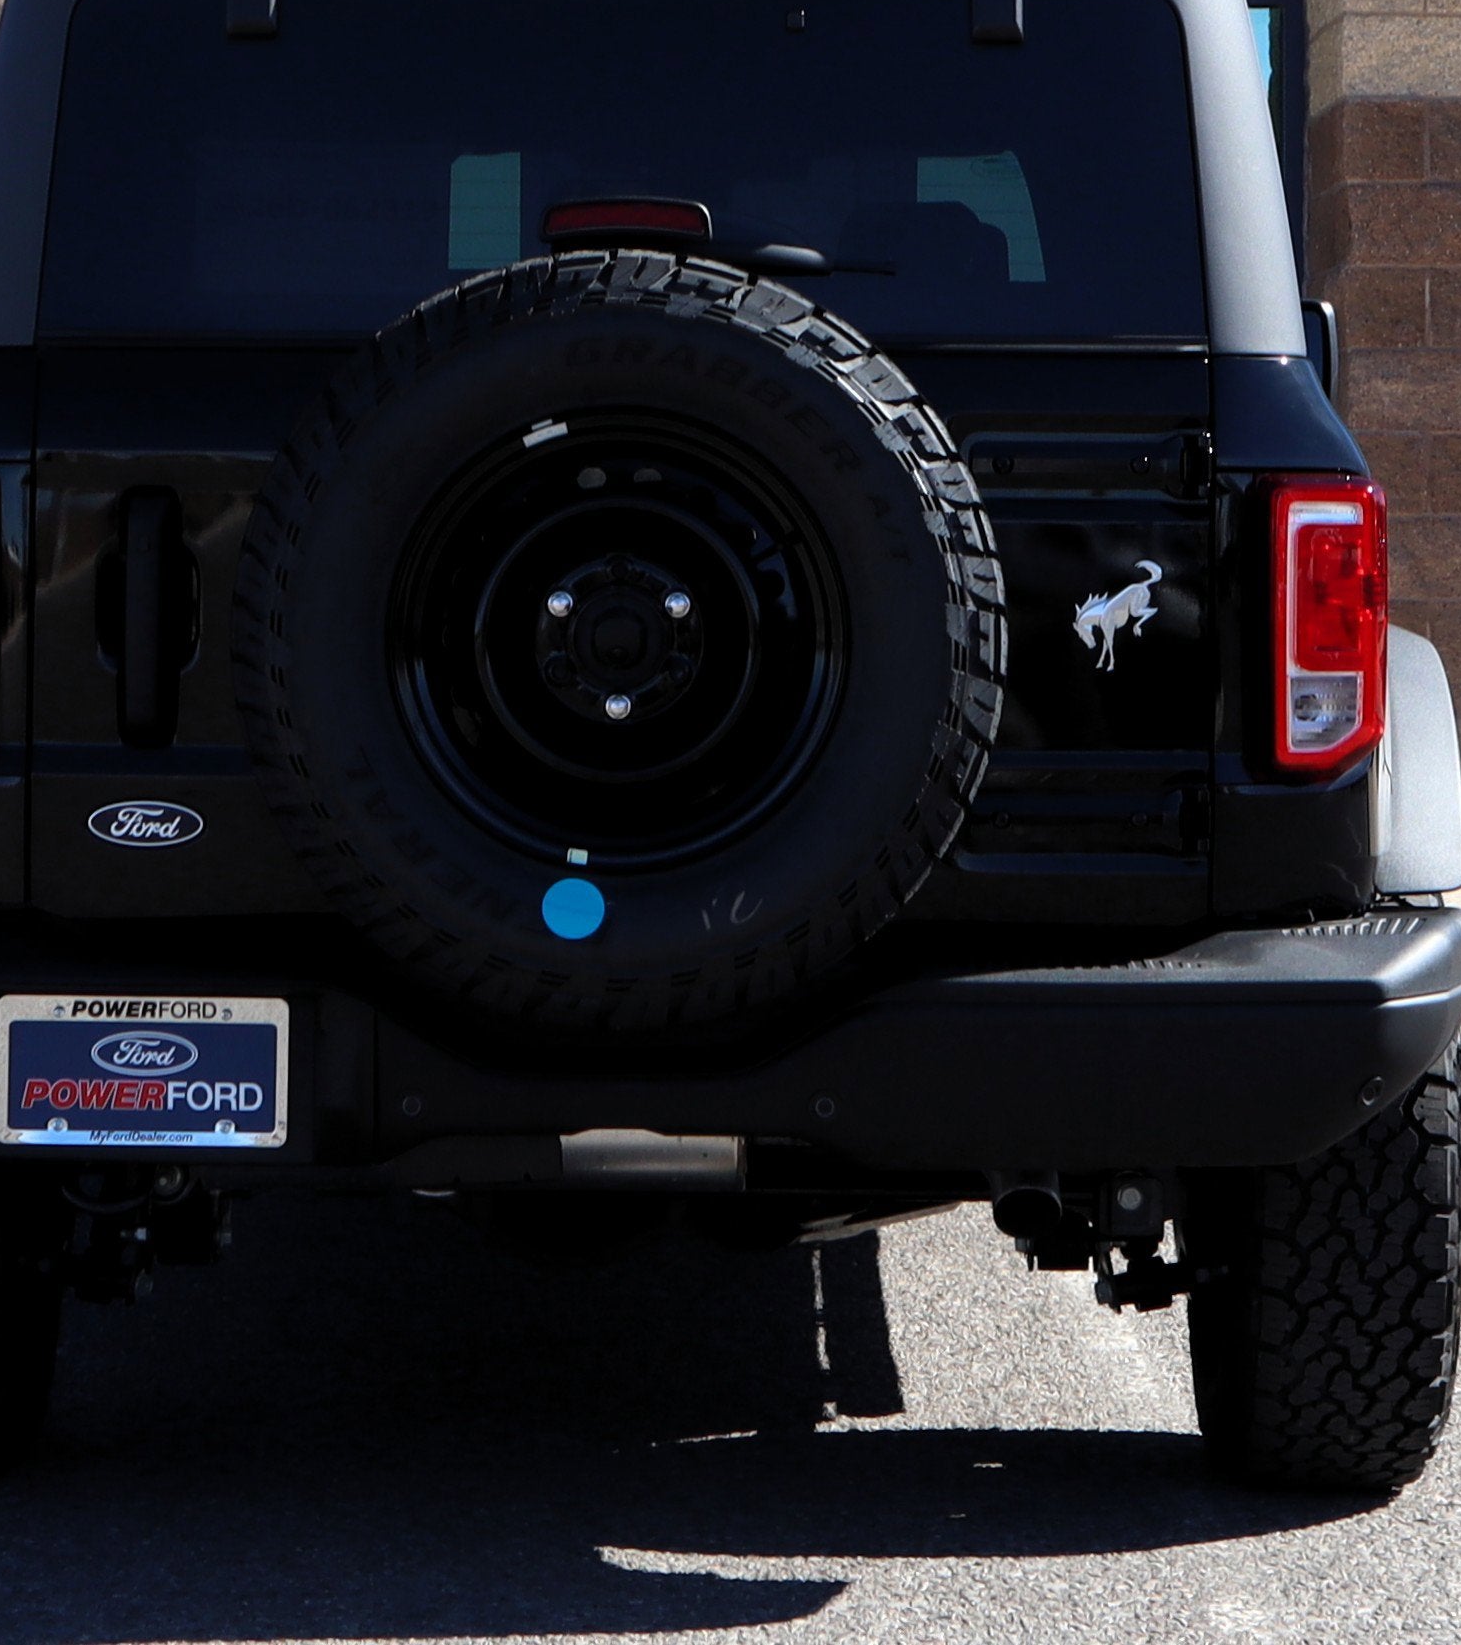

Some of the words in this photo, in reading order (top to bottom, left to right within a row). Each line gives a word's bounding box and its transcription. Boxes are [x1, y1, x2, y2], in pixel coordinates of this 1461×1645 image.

[565, 336, 862, 471] GRABBER
[109, 807, 181, 839] Ford
[112, 1038, 177, 1066] Ford
[89, 1129, 194, 1145] MyFordDealer.com
